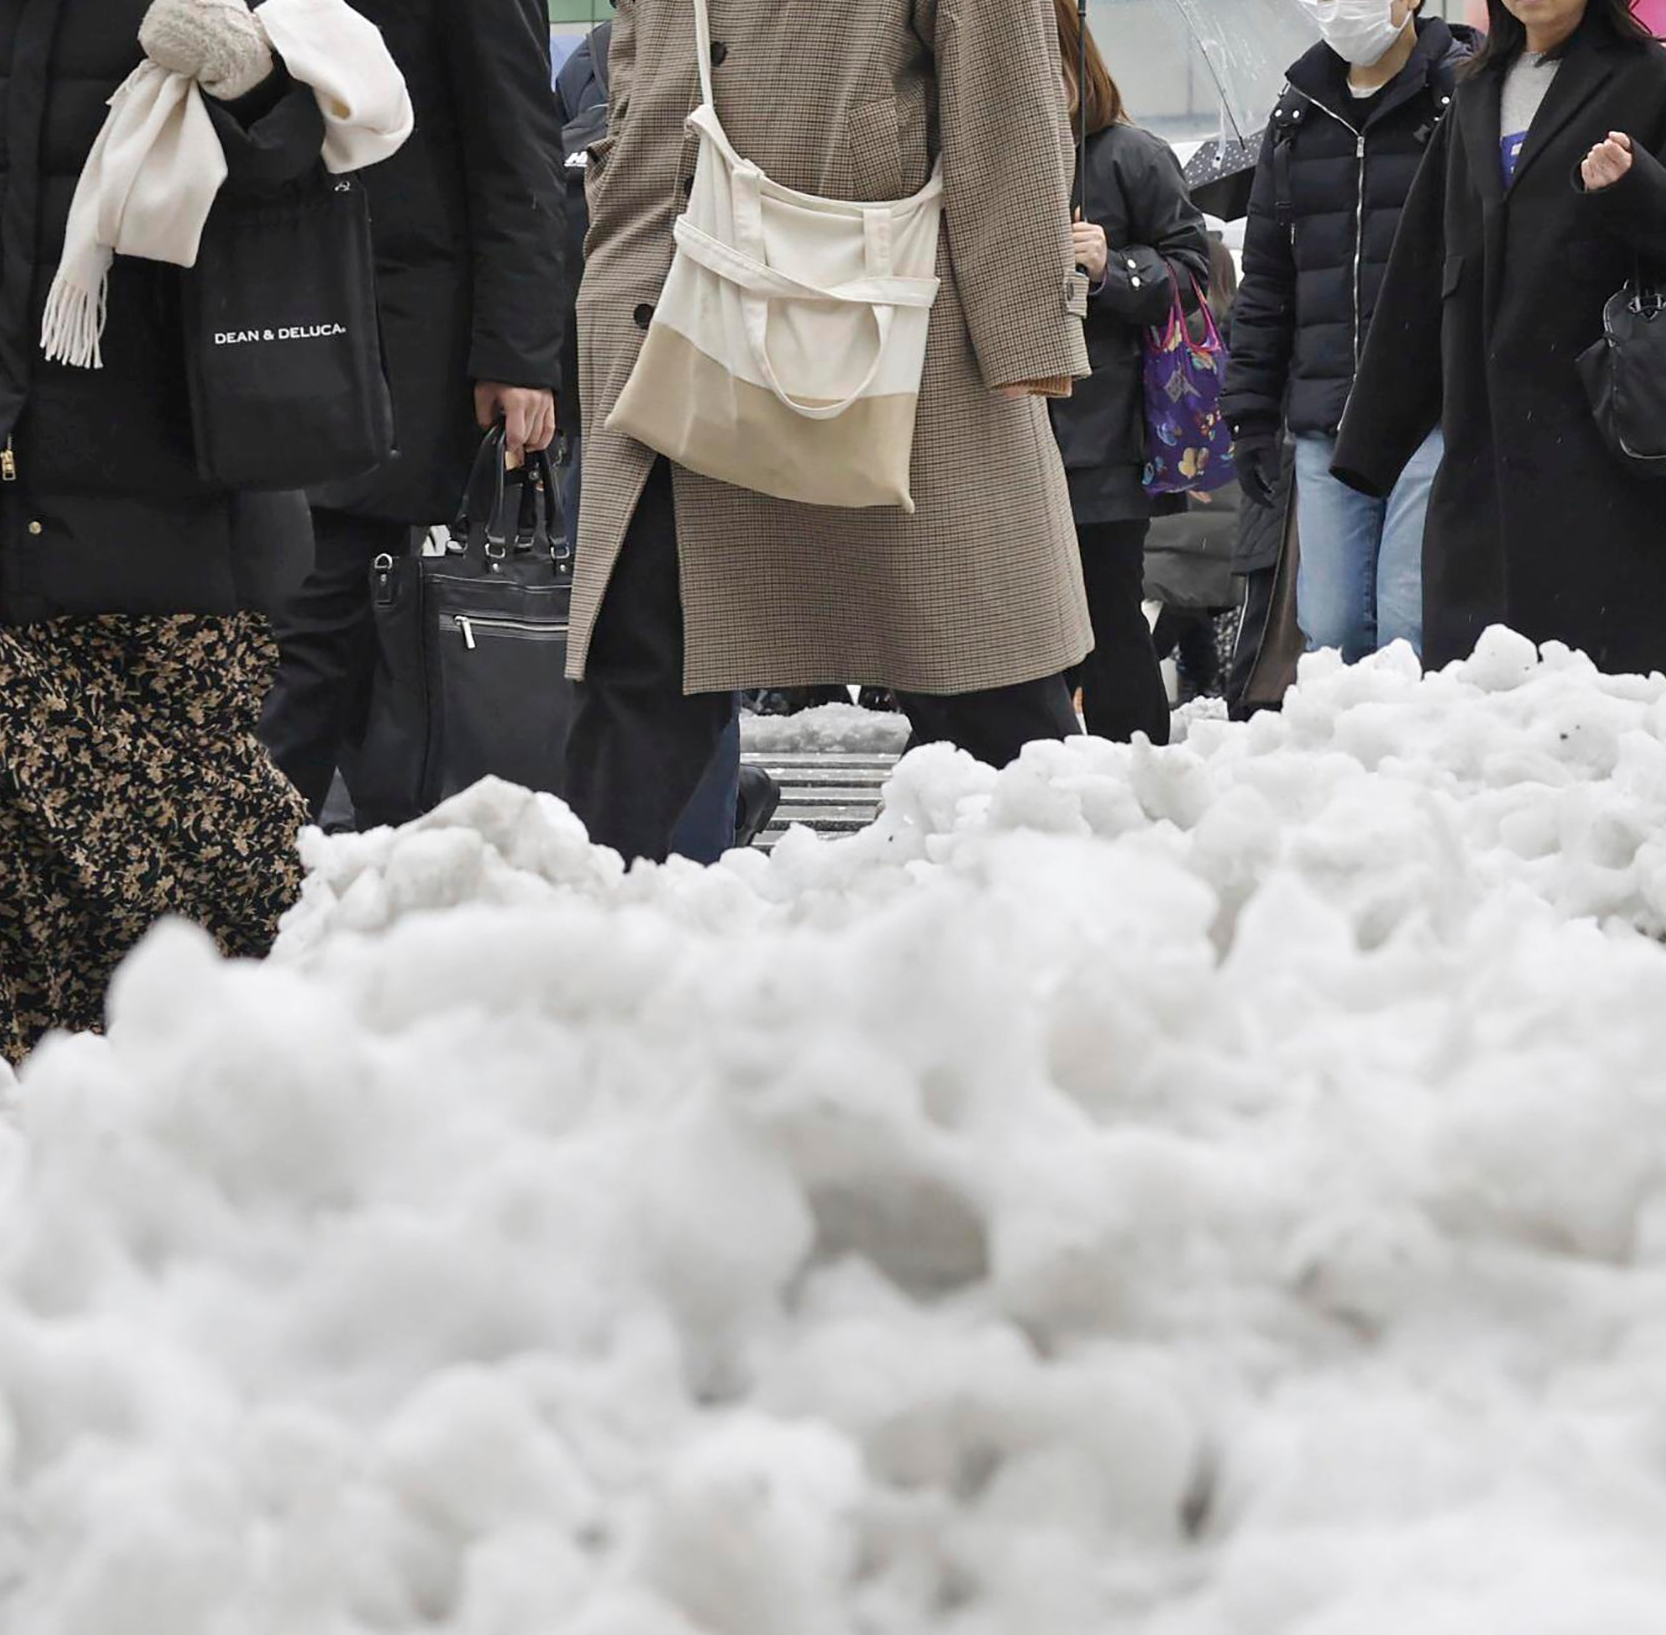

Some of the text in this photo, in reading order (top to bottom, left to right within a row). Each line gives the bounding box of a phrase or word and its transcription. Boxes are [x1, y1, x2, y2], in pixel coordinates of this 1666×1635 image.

[215, 322, 342, 345] DEAN & DELUCA
